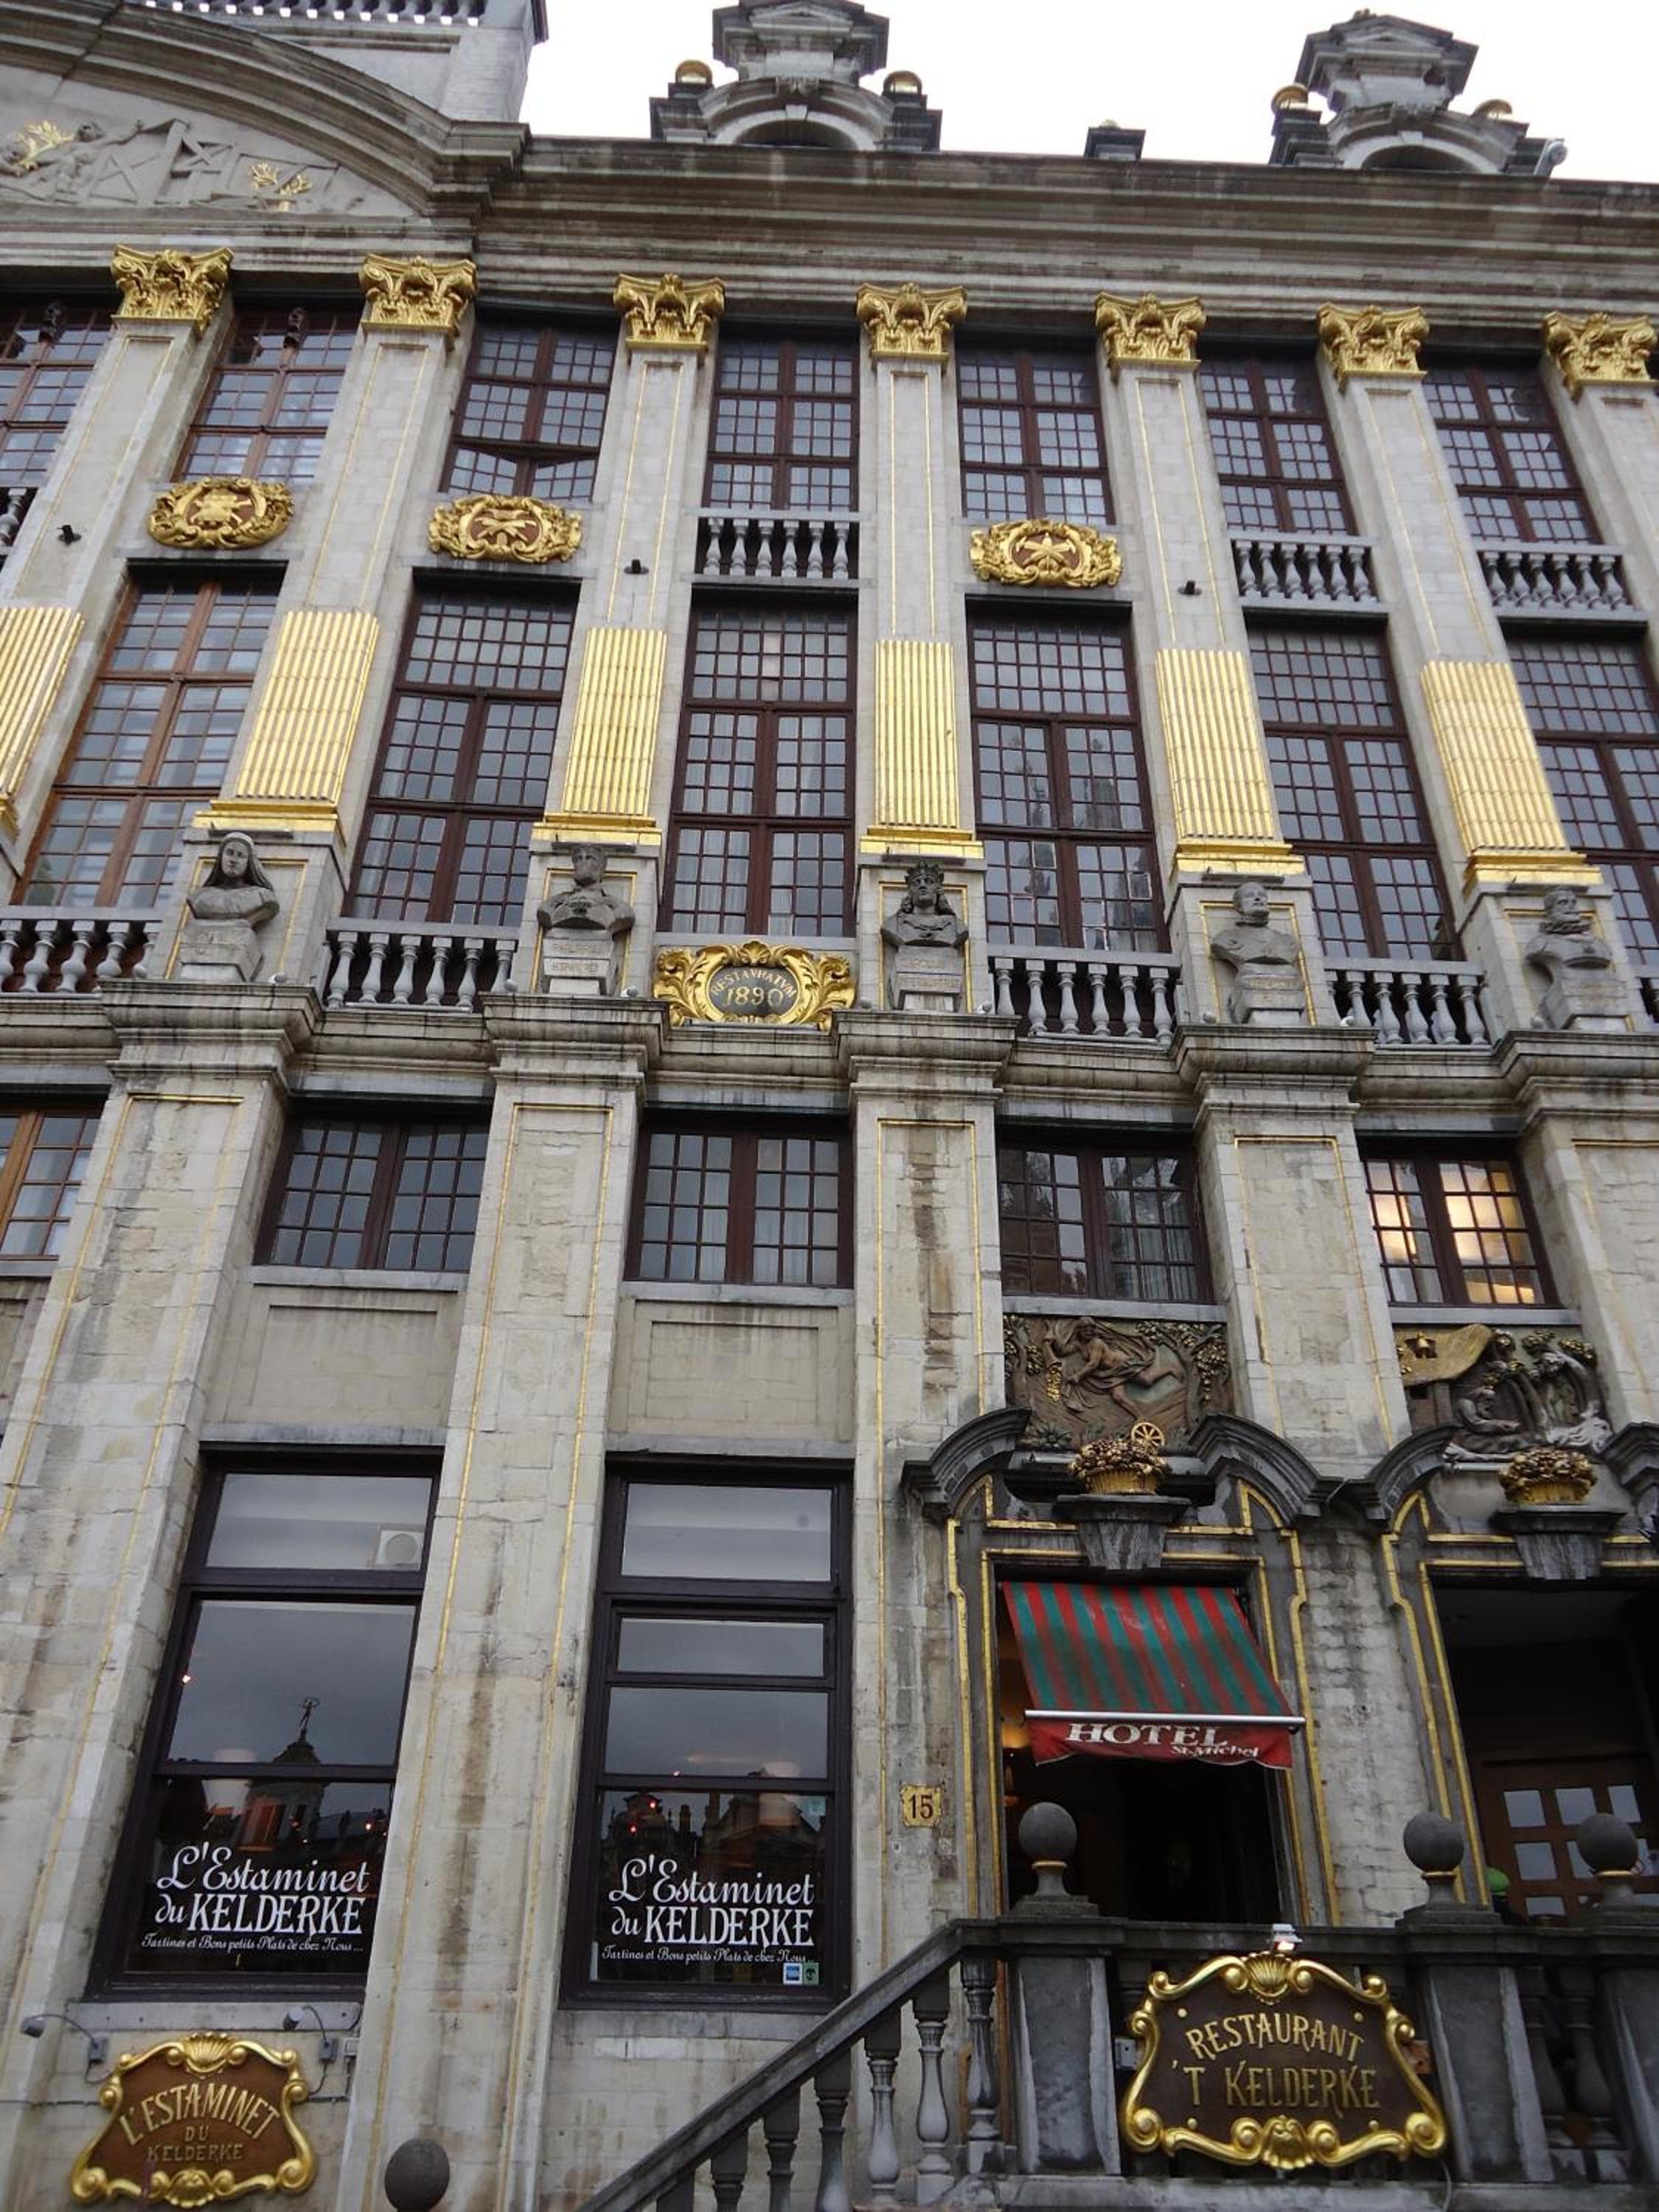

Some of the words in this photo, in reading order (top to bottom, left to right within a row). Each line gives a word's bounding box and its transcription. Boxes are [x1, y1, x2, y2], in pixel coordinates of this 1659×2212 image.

[726, 986, 784, 1007] 1890
[1065, 1722, 1228, 1747] HOTEL
[909, 1792, 934, 1820] 15
[156, 1841, 370, 1893] L'Estaminet
[608, 1854, 815, 1905] L'Estaminet
[155, 1894, 187, 1924] du
[187, 1893, 366, 1937] KELDERKE
[611, 1906, 642, 1935] du
[643, 1905, 815, 1950] KELDERKE
[141, 1931, 184, 1947] Tartines
[187, 1937, 197, 1948] et
[198, 1934, 226, 1949] Bons
[227, 1938, 255, 1954] petits
[257, 1935, 286, 1950] Plats
[287, 1937, 298, 1950] de
[299, 1937, 319, 1951] chez
[602, 1944, 644, 1959] Tartines
[645, 1949, 654, 1959] et
[657, 1946, 684, 1961] Bons
[685, 1950, 712, 1966] petits
[713, 1947, 742, 1962] Plats
[742, 1950, 754, 1962] de
[754, 1949, 774, 1962] chez
[1185, 2013, 1364, 2062] RESTAURANT
[1224, 2060, 1381, 2118] KELDERKE
[119, 2082, 281, 2146] L'ESTAMINET
[184, 2126, 211, 2141] DU
[147, 2143, 243, 2163] KELDERKE
